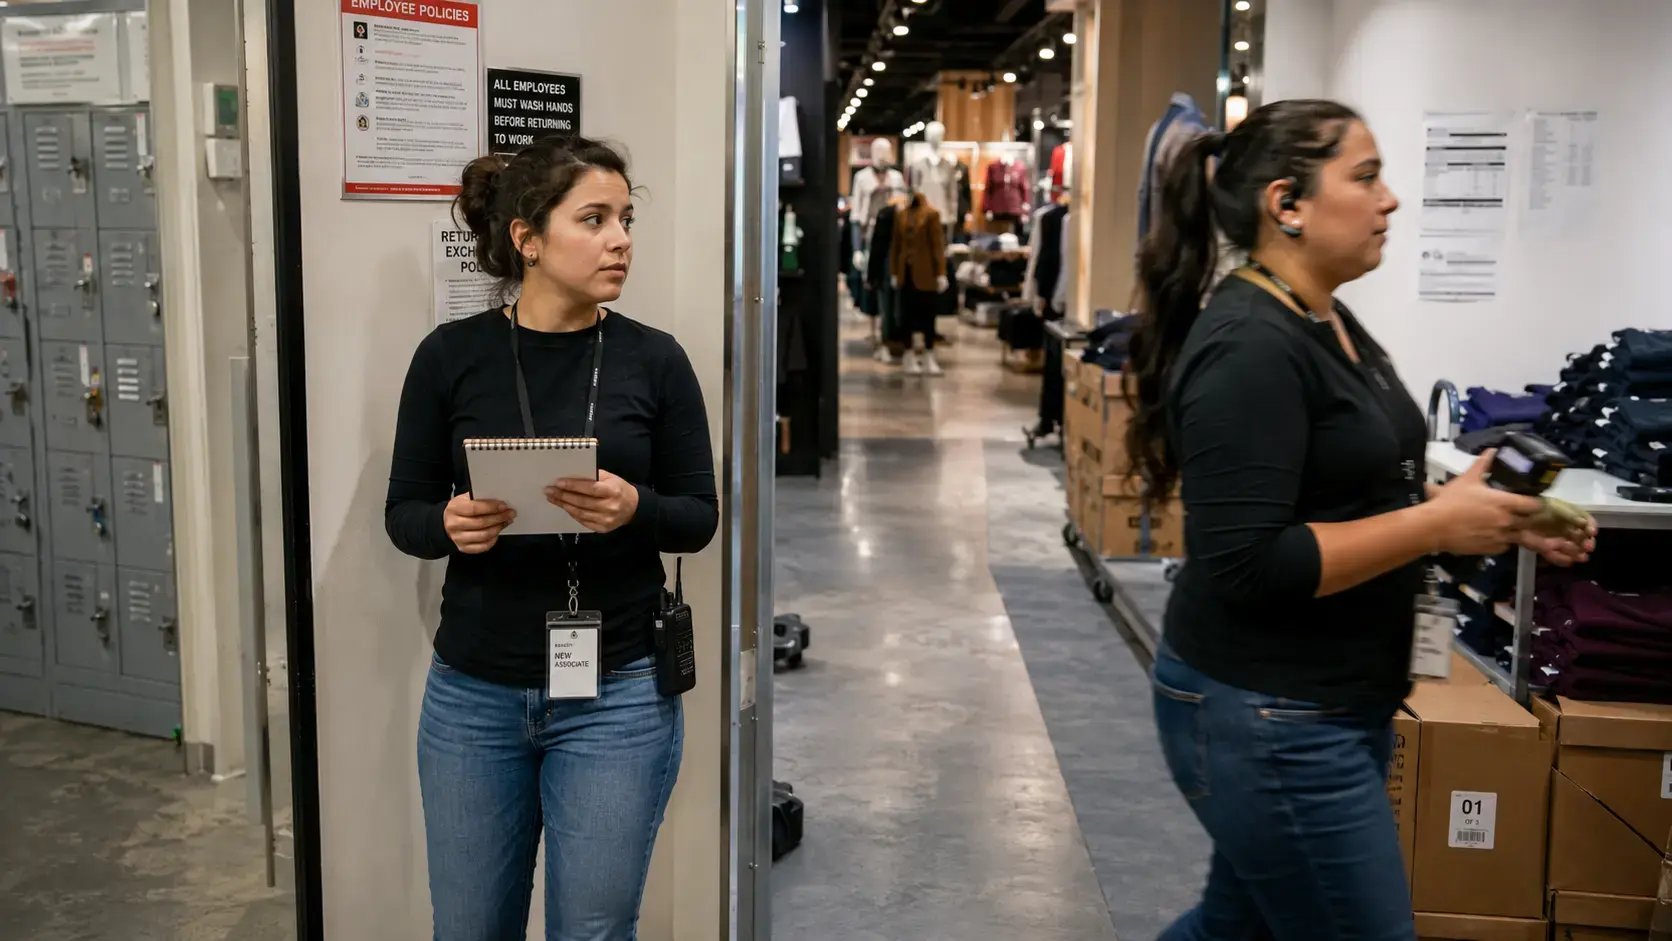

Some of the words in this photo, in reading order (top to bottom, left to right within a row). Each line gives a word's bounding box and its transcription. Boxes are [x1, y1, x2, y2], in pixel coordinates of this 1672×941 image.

[351, 0, 416, 15] EMPLOYEE
[420, 5, 469, 22] POLICIES
[494, 79, 511, 90] ALL
[513, 80, 566, 95] EMPLOYEES
[494, 97, 518, 109] MUST
[520, 99, 544, 111] WASH
[546, 101, 574, 114] HANDS
[494, 115, 526, 128] BEFORE
[527, 117, 572, 131] RETURNING
[494, 133, 506, 144] TO
[508, 134, 534, 145] WORK
[441, 230, 478, 242] RETUR
[445, 245, 476, 258] EXCH
[460, 261, 483, 273] POL
[554, 652, 572, 660] NEW
[554, 660, 589, 668] ASSOCIATE
[1462, 799, 1482, 815] 01
